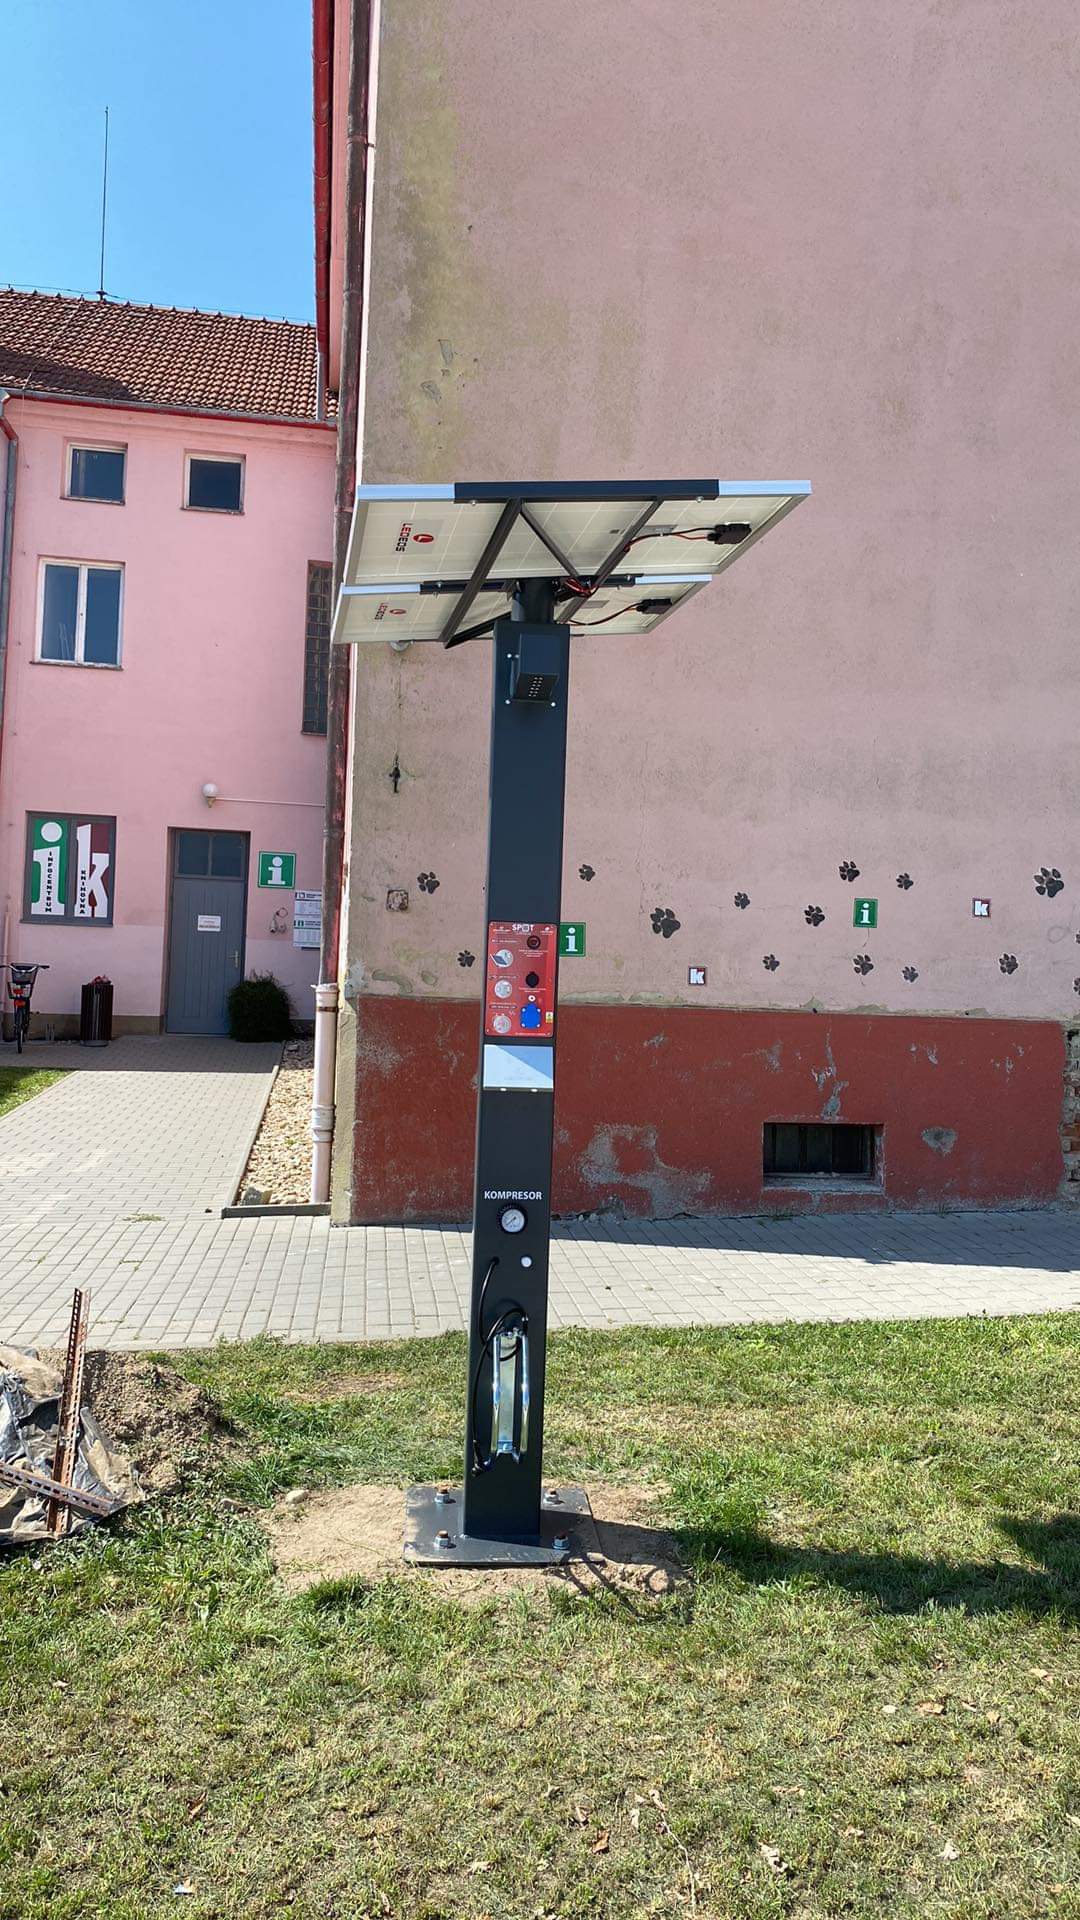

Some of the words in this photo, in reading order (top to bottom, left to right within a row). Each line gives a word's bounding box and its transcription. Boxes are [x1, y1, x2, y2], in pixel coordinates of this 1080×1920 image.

[45, 851, 53, 912] INFOCENTRUM
[512, 923, 535, 932] SPOT
[484, 1190, 542, 1200] KOMPRESOR
